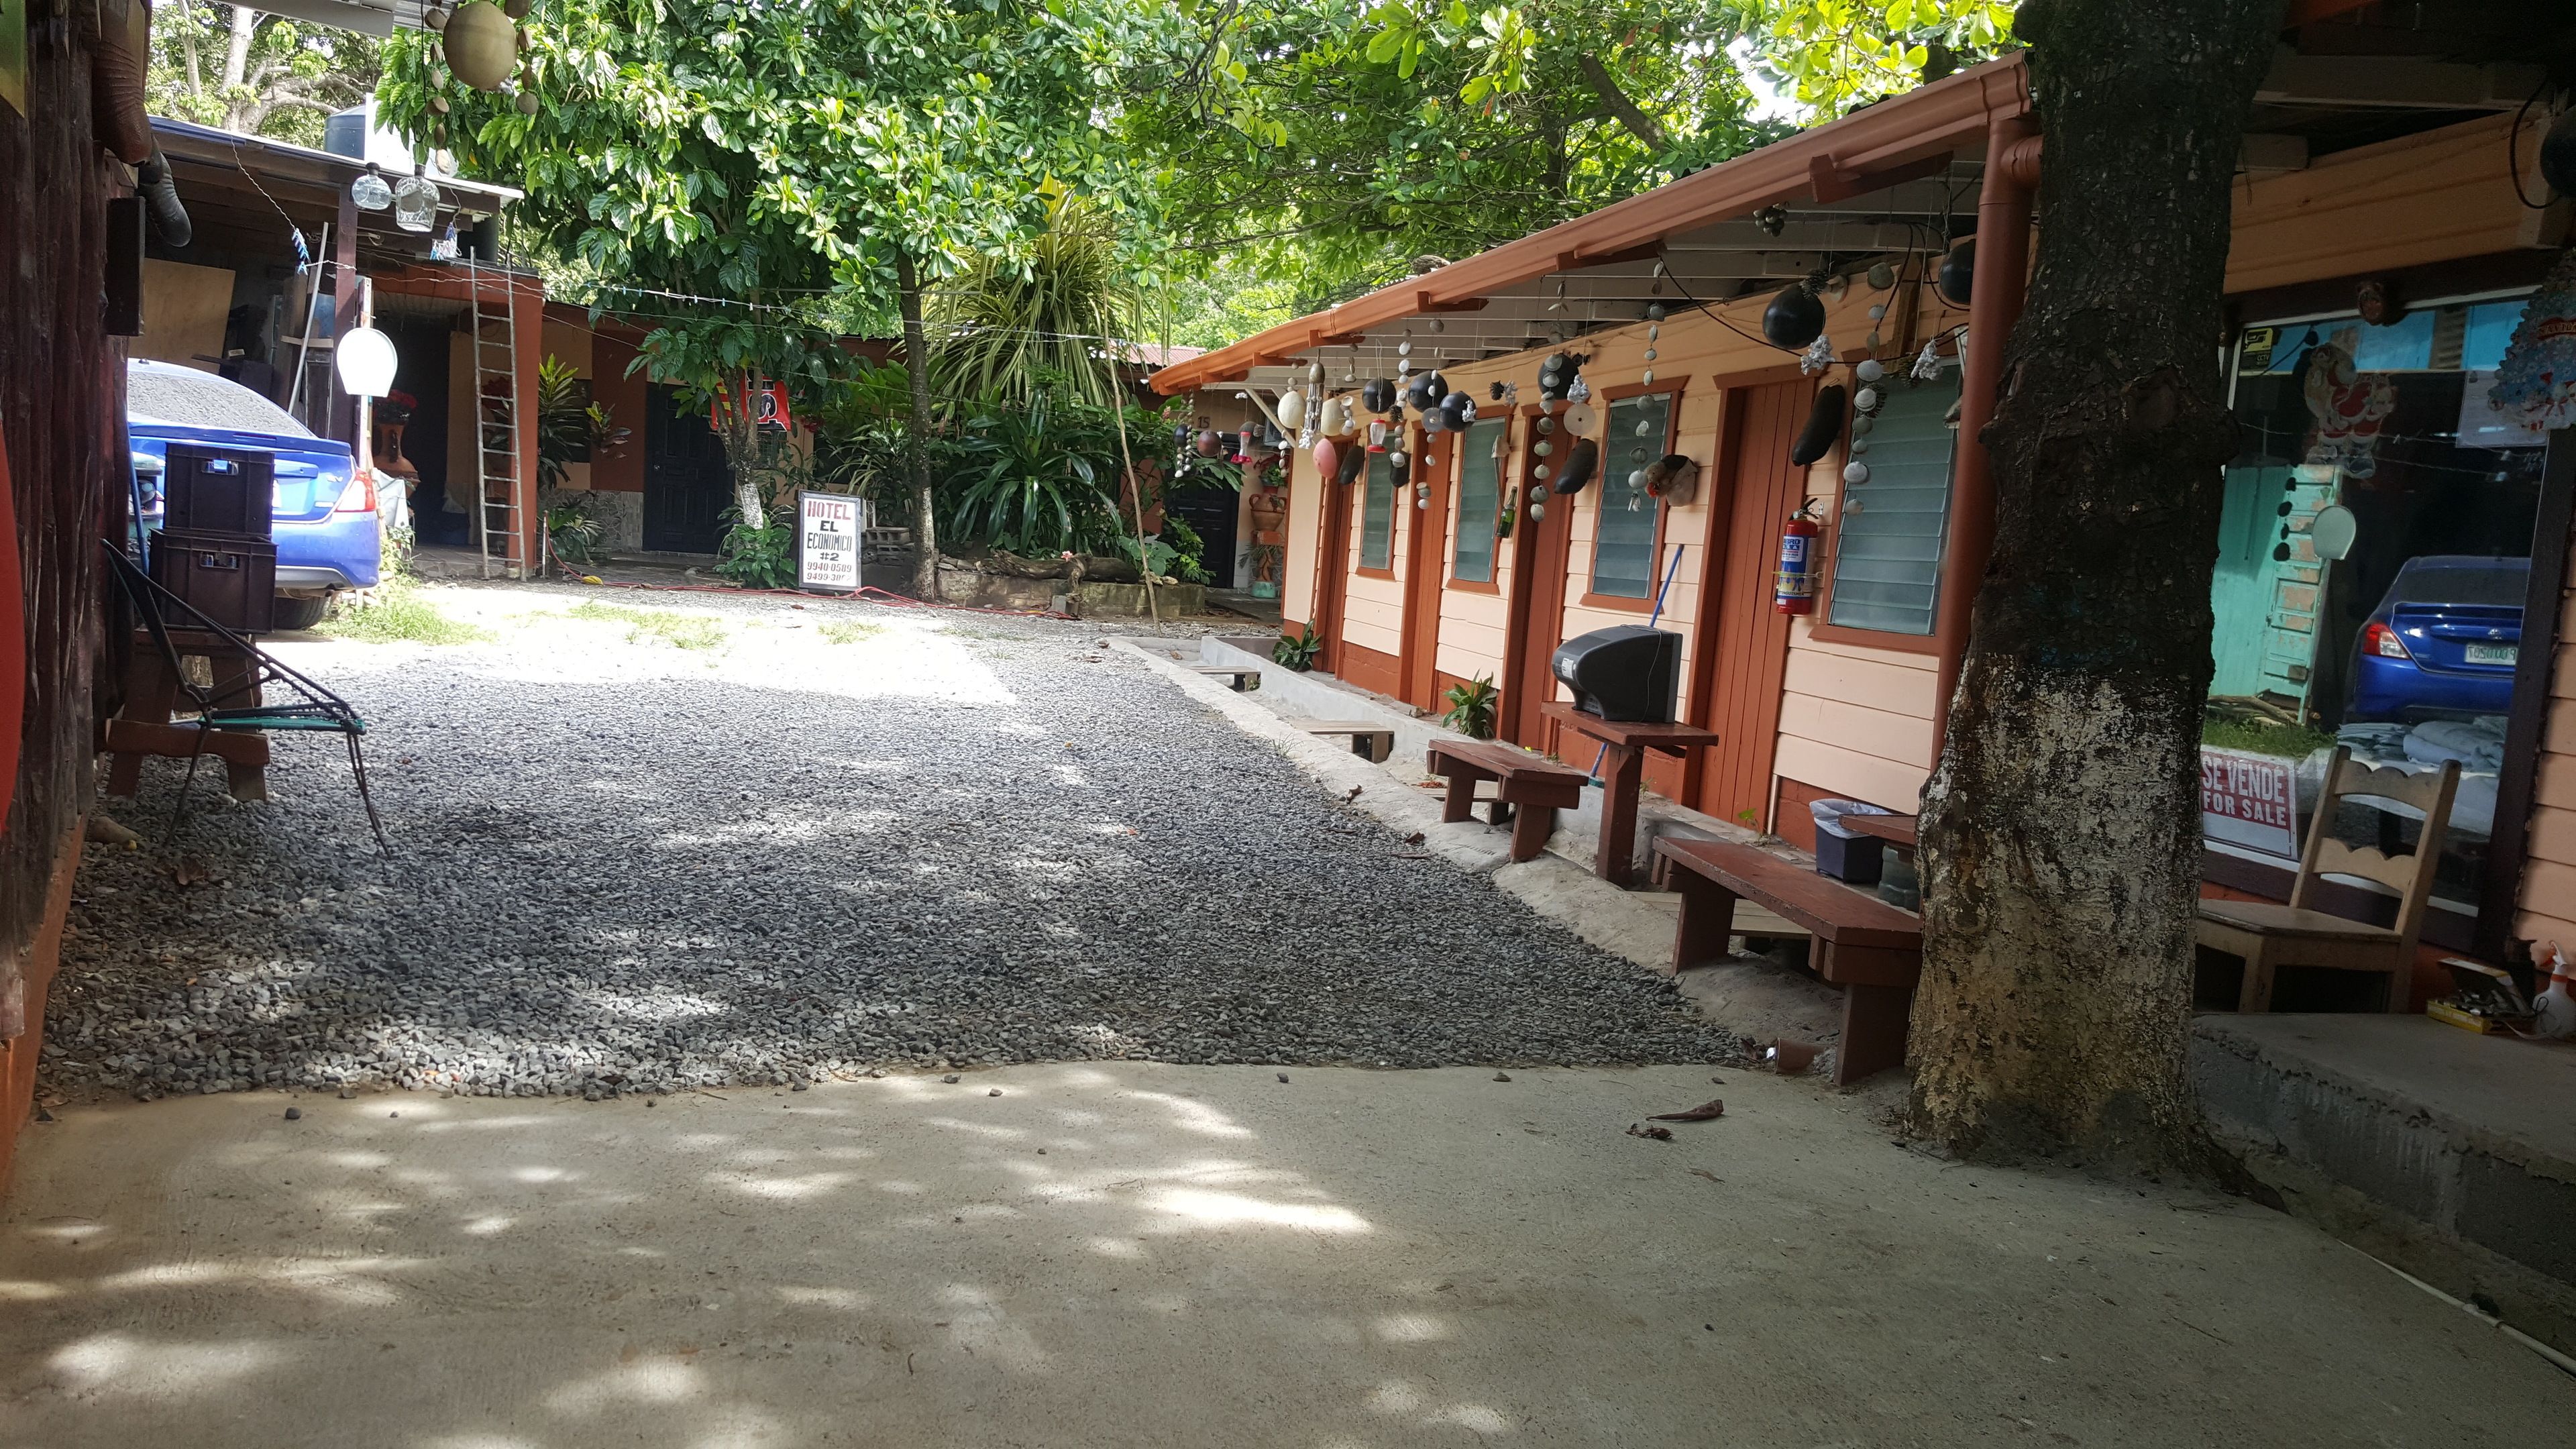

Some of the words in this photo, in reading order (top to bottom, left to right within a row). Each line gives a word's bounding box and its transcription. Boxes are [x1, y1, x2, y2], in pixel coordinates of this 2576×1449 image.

[1197, 415, 1210, 429] 15
[807, 501, 851, 520] HOTEL
[820, 520, 839, 532] EL
[807, 533, 853, 552] ECONOMICO
[820, 552, 839, 561] #2
[2202, 755, 2223, 792] SE
[2226, 759, 2286, 804] VENDE
[2203, 791, 2236, 815] FOR
[2242, 798, 2287, 826] SALE
